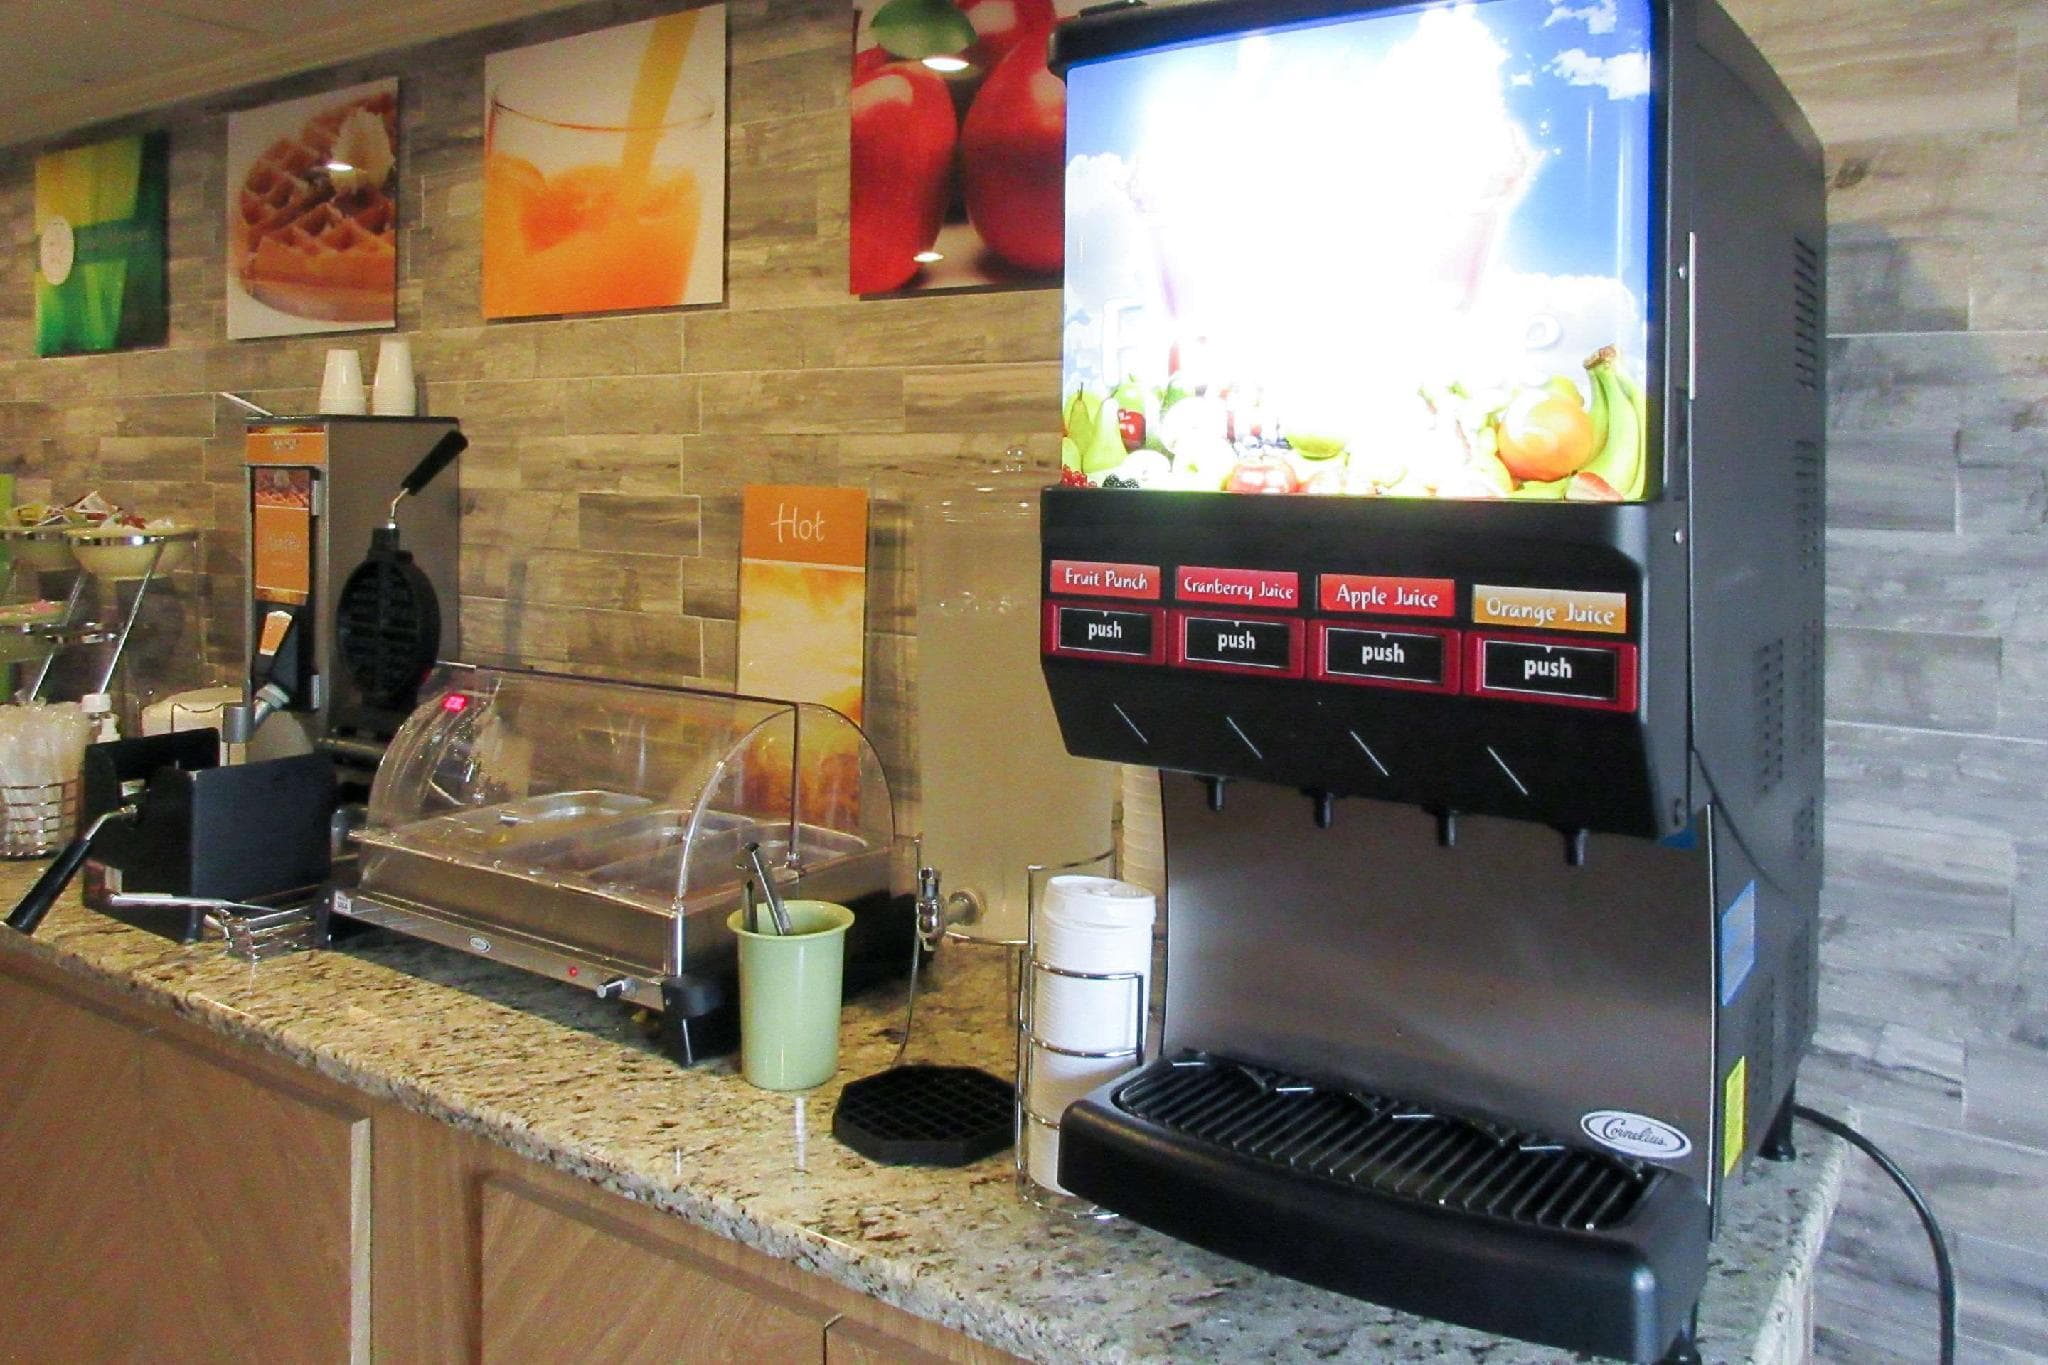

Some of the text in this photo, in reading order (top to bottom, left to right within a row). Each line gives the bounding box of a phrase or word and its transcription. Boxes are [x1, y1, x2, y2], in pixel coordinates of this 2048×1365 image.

[769, 502, 825, 543] Hot
[1065, 567, 1148, 590] Fruit Punch
[1184, 576, 1294, 600] Cranberry Juice
[1336, 583, 1439, 609] Apple Juice
[1486, 598, 1615, 626] Orange Juice
[1088, 621, 1122, 641] push
[1217, 630, 1256, 652] push
[1361, 643, 1405, 665] push
[1524, 656, 1573, 680] push
